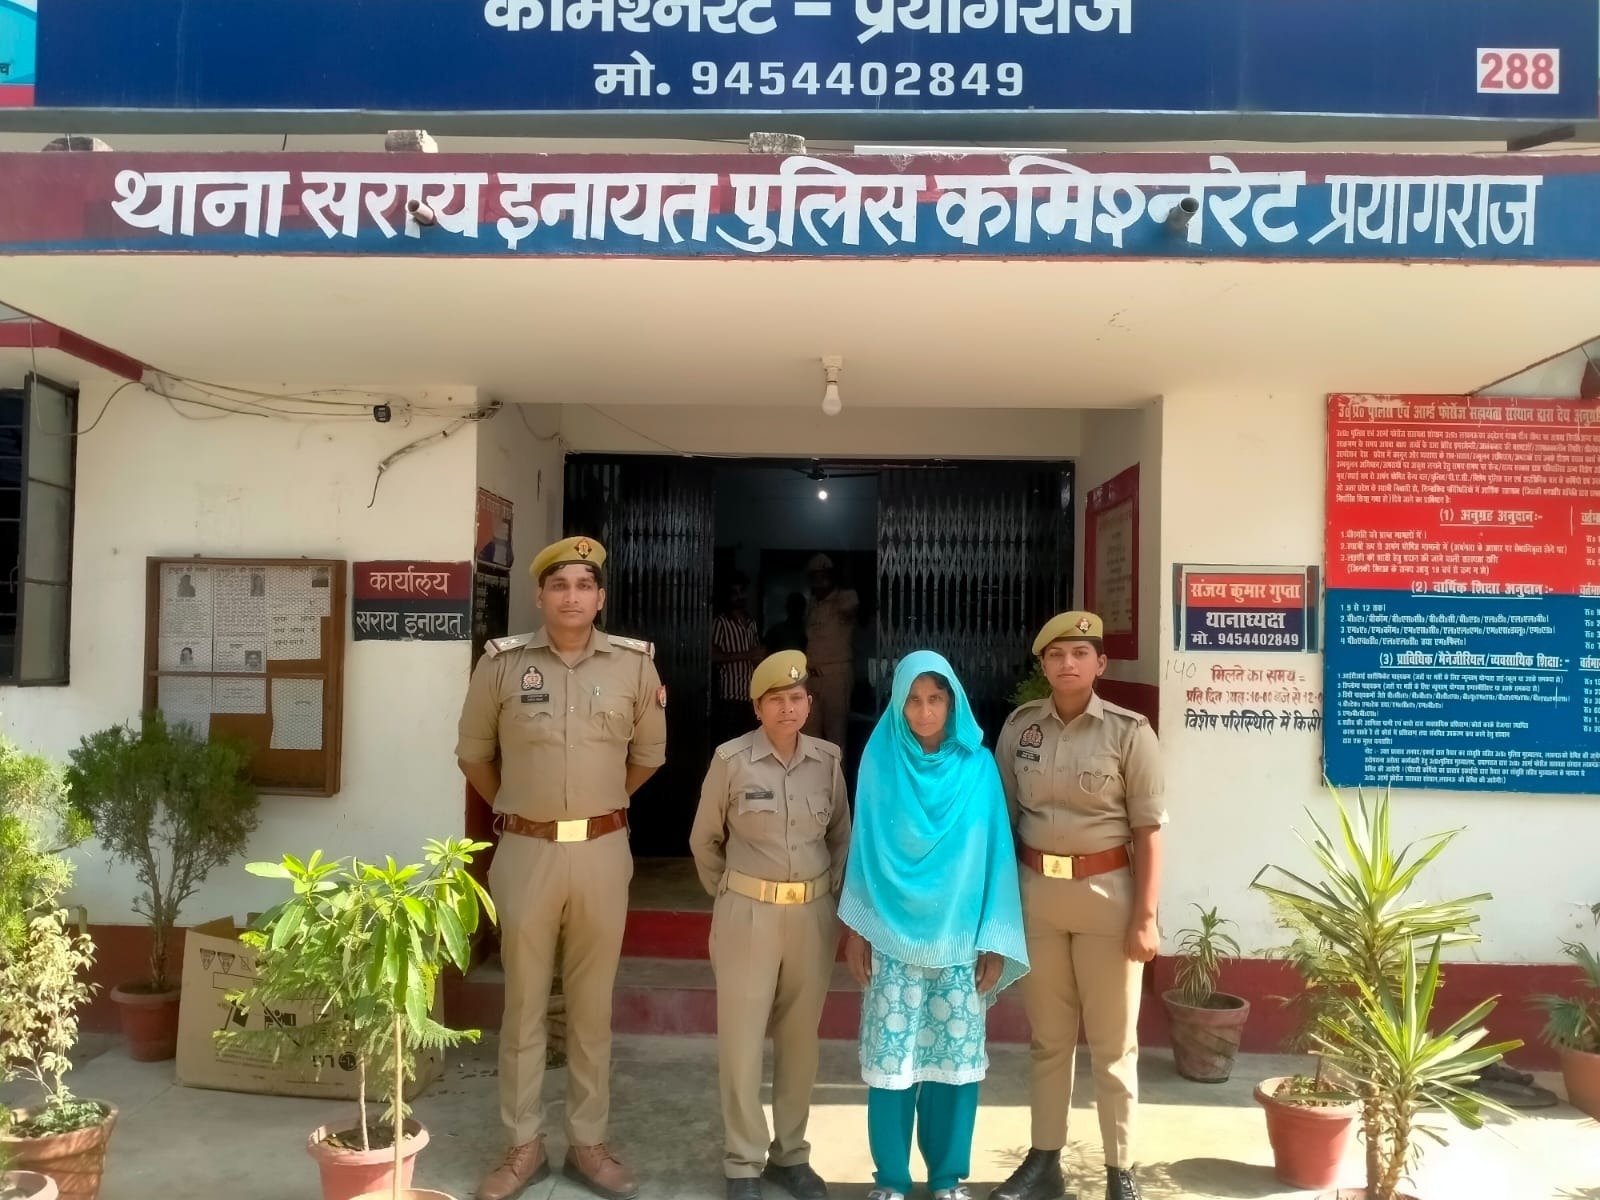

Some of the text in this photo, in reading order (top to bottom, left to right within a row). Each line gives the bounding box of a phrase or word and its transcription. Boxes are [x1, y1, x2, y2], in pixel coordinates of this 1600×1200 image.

[857, 0, 1132, 43] प्रयागराज
[594, 51, 1024, 97] मो. 9454402849
[1480, 52, 1555, 90] 288
[111, 168, 291, 239] थाना
[301, 170, 488, 240] सराय
[495, 172, 719, 251] इनायत
[714, 153, 927, 253] पुलिस
[1307, 175, 1544, 249] प्रयागराज
[1439, 507, 1455, 522] (1)
[1461, 509, 1494, 524] अनुग्रह
[369, 565, 451, 597] कार्यालय
[1190, 578, 1302, 603] संजय कुमार गुप्ता
[1411, 579, 1428, 594] (2)
[355, 611, 464, 637] सराय इनायत
[1205, 612, 1287, 629] थानाध्यक्ष
[1191, 630, 1299, 646] मो. 9454402849
[1380, 652, 1394, 666] (3)
[1184, 708, 1218, 731] विशेष
[1220, 709, 1278, 735] परिस्थिति
[1280, 710, 1291, 731] में
[1294, 710, 1323, 732] किसी
